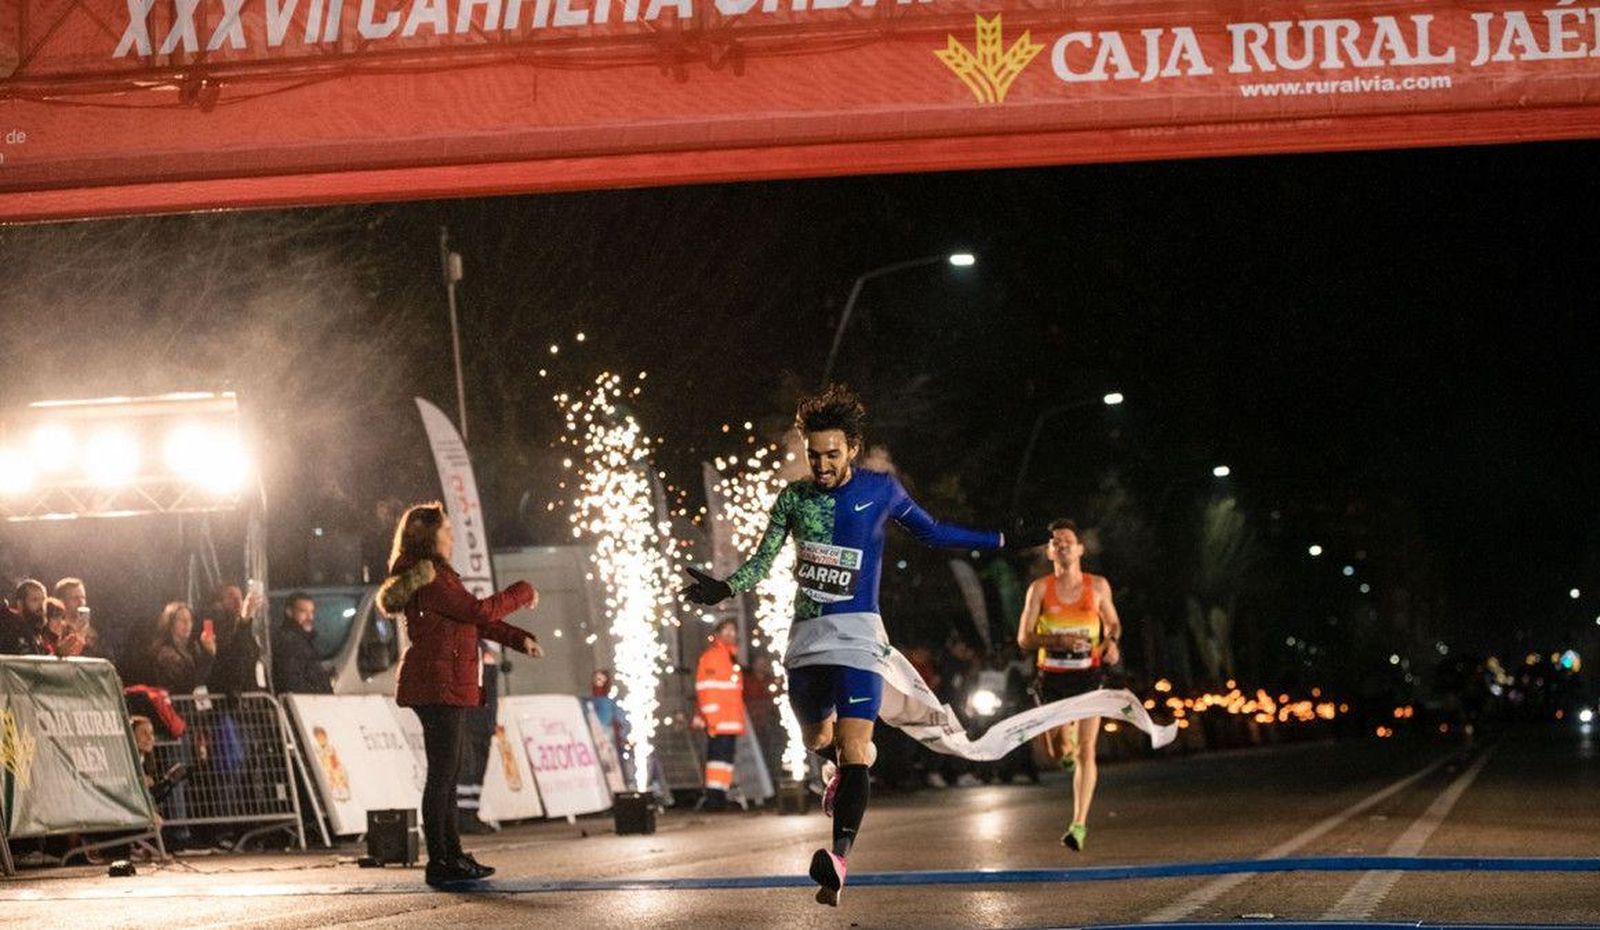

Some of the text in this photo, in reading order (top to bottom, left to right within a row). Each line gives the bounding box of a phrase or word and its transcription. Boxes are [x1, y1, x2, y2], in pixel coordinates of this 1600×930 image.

[1052, 0, 1600, 83] CAJA RURAL JAÉ
[1241, 75, 1453, 97] www.ruralvia.com
[6, 129, 26, 144] de
[798, 563, 852, 586] CARRO
